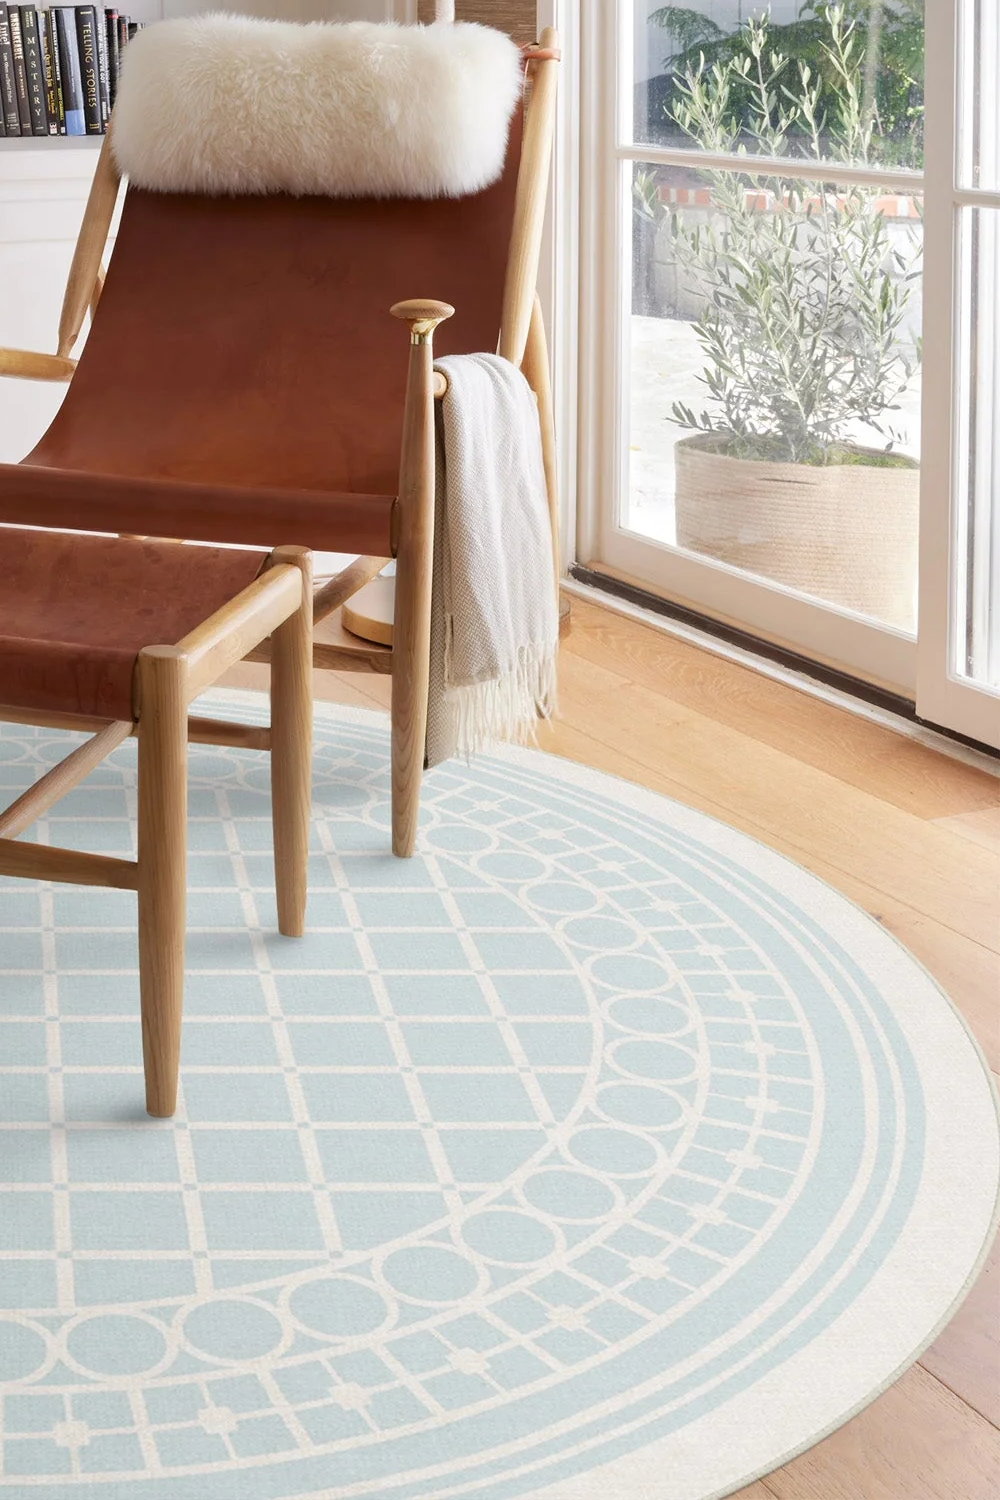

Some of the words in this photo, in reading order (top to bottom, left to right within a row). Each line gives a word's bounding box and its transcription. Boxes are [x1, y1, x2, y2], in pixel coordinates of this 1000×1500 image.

[10, 12, 23, 60] UNSHAKEABLE
[82, 22, 94, 63] TELLING
[86, 68, 97, 108] STORIES
